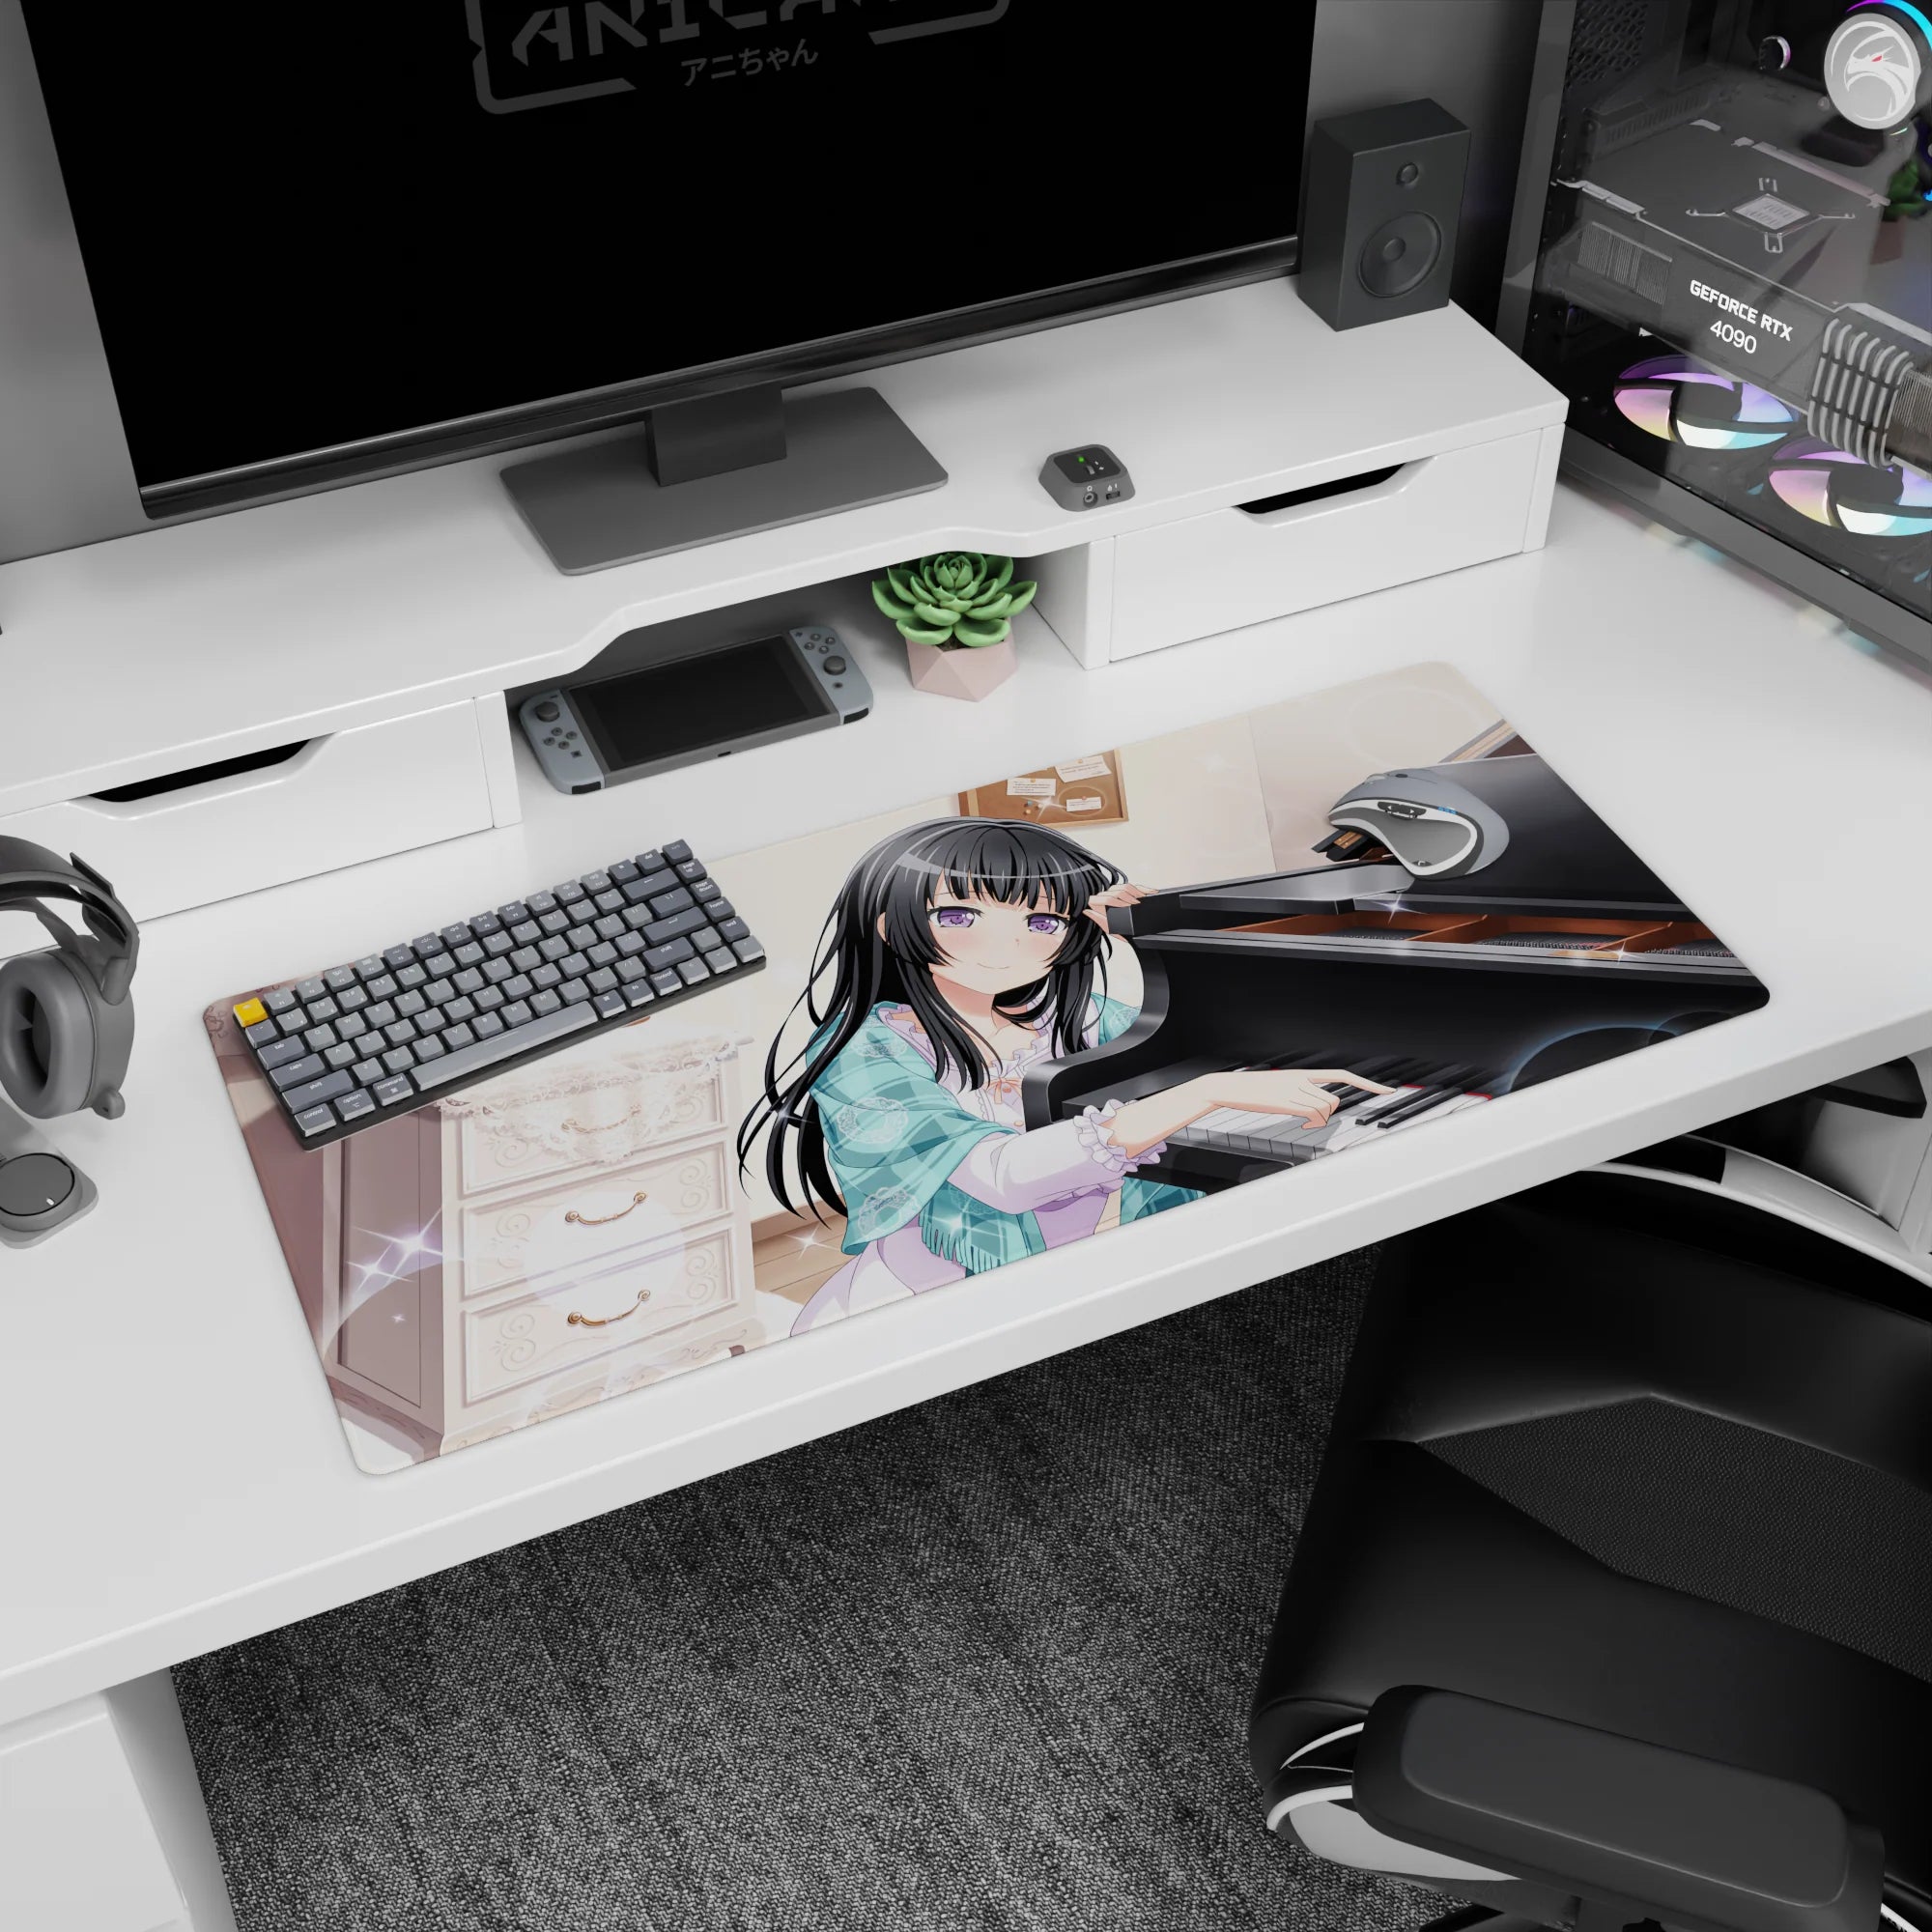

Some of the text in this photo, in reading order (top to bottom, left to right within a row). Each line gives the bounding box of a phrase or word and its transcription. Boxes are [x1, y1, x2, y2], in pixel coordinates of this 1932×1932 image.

[681, 39, 818, 86] アニちゃん
[1690, 279, 1794, 342] GEFORCE RTX
[1709, 320, 1757, 355] 4090
[709, 900, 724, 909] home
[654, 971, 672, 981] control
[309, 1081, 323, 1091] shift
[377, 1076, 404, 1091] command
[343, 1094, 361, 1104] option
[303, 1108, 324, 1120] control
